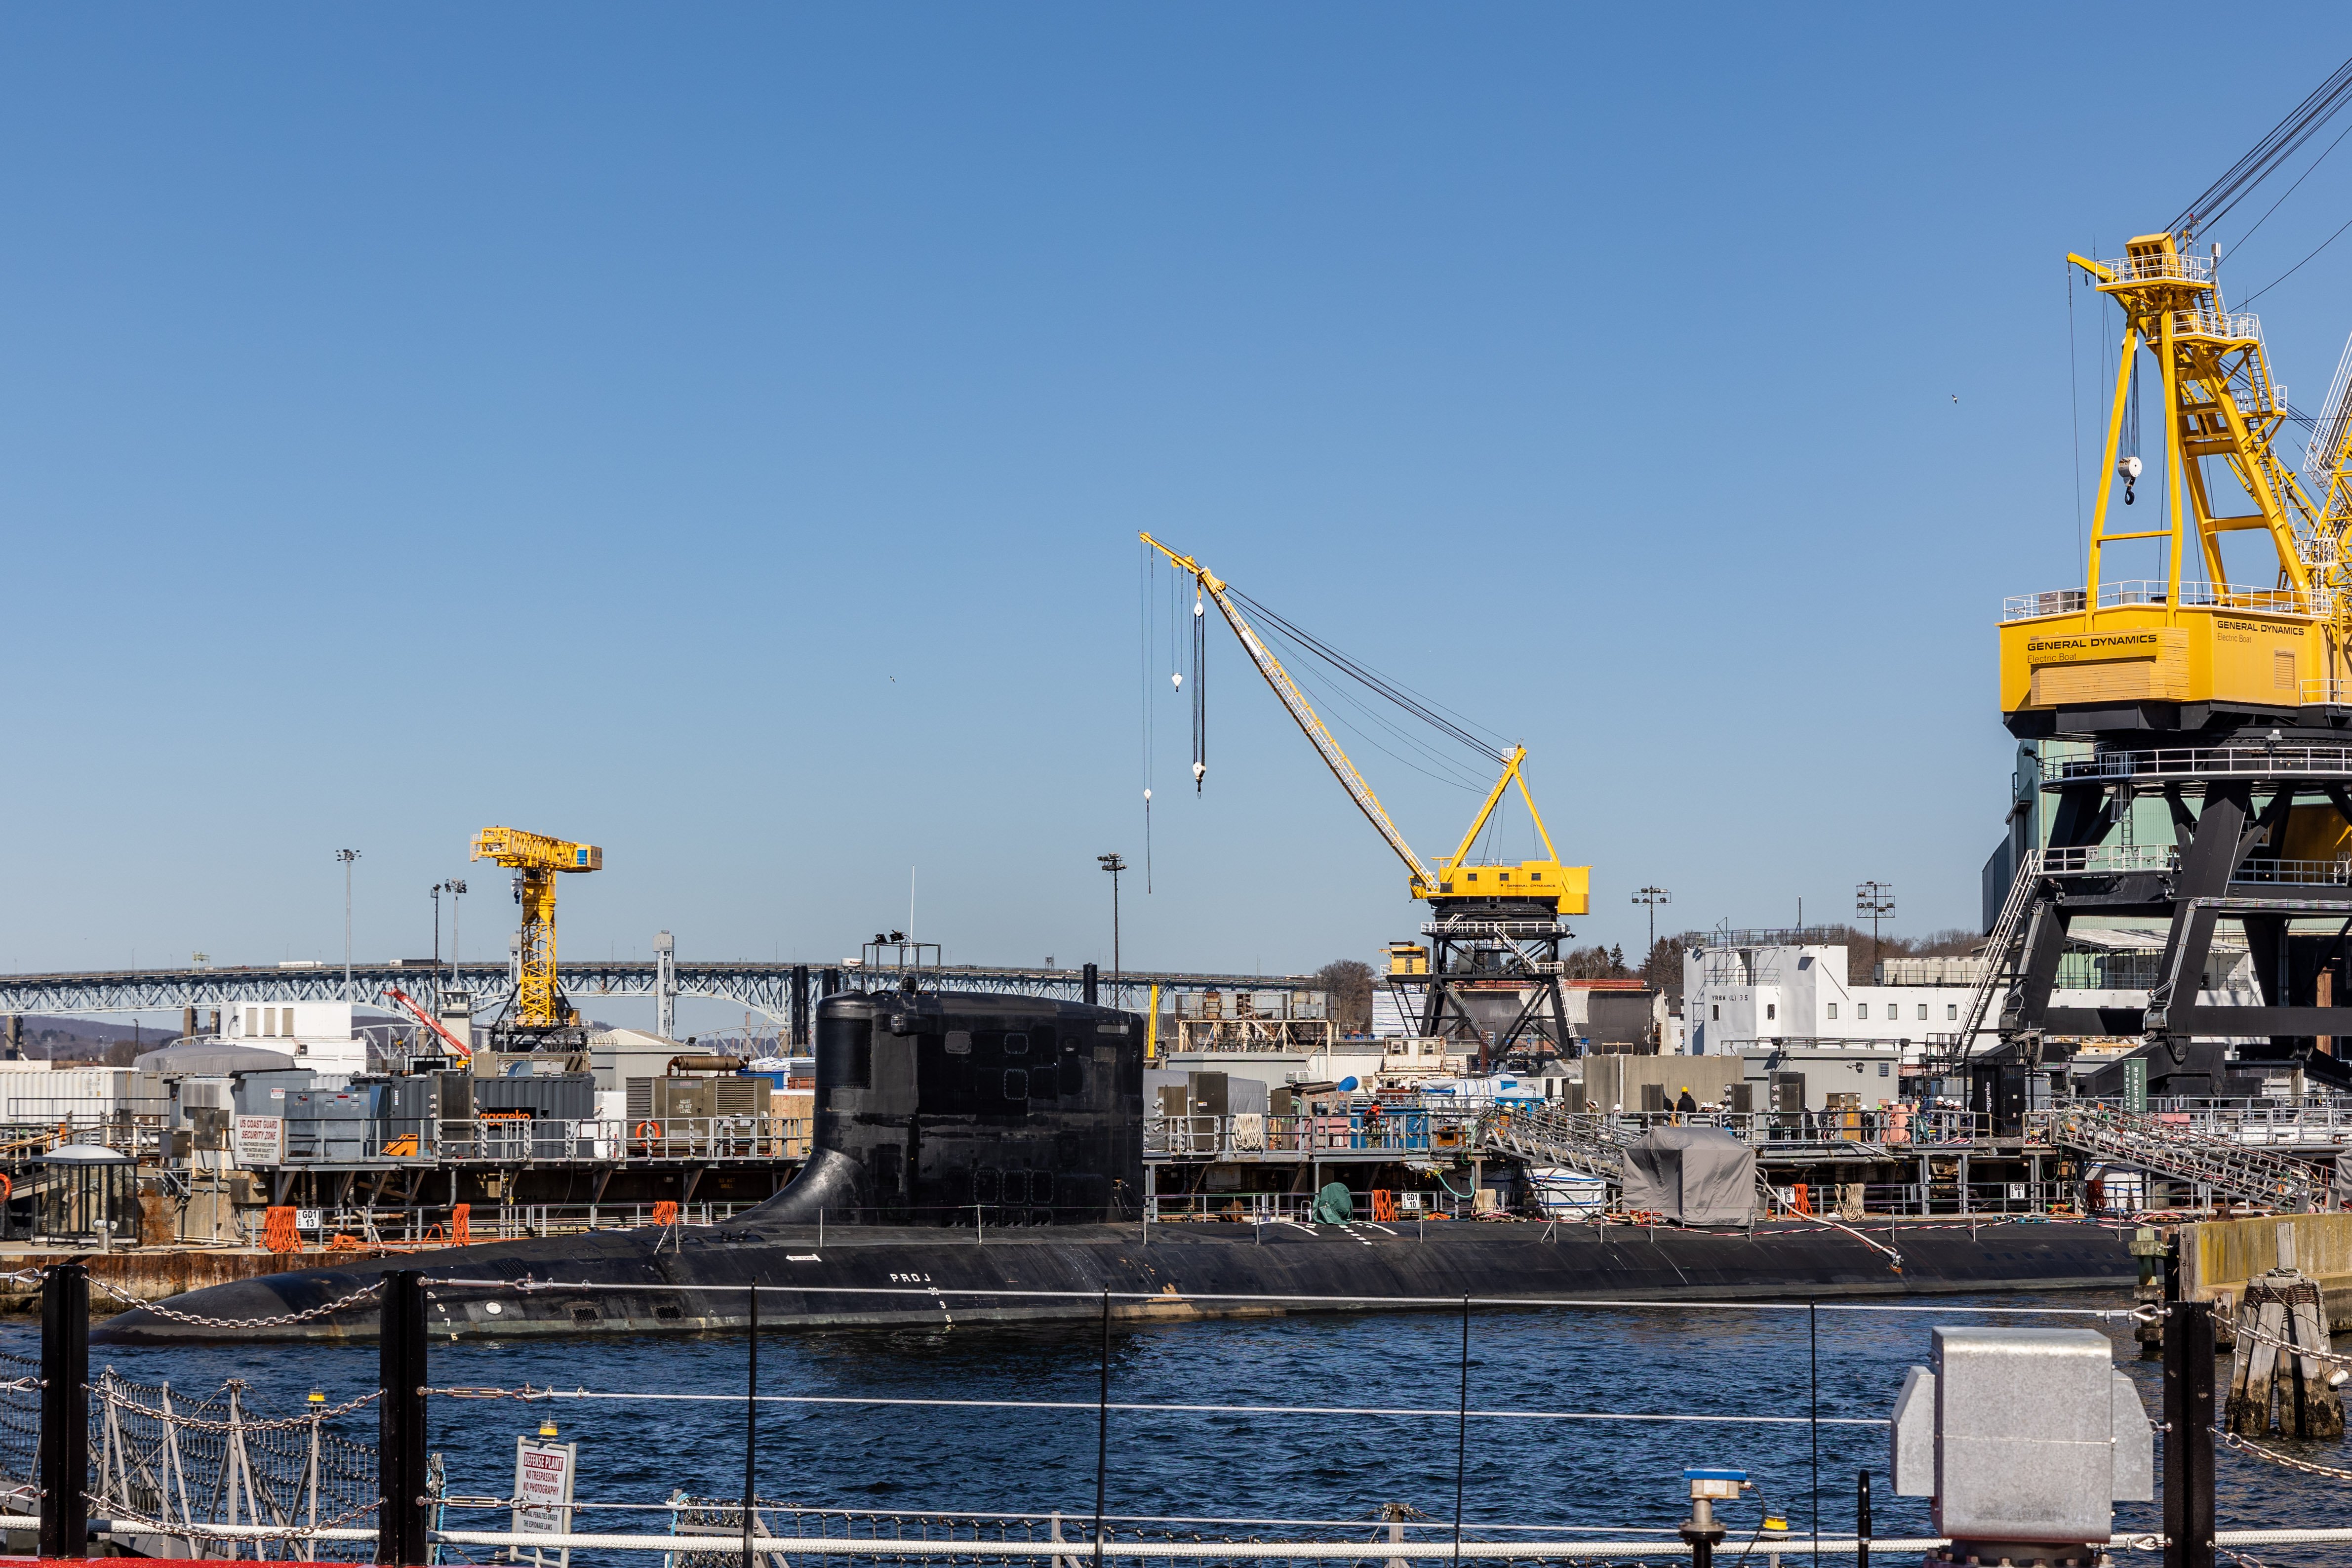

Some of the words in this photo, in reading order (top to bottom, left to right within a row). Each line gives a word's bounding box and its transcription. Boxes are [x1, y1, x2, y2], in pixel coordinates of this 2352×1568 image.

[2218, 621, 2258, 631] GENERAL
[2261, 624, 2304, 636] DYNAMICS
[2028, 640, 2087, 651] GENERAL
[2091, 635, 2157, 647] DYNAMICS
[2217, 633, 2237, 642] Electric
[2239, 635, 2251, 643] Boat
[2028, 654, 2056, 663] Electric
[403, 999, 419, 1011] SANY
[480, 1109, 530, 1126] aggreko
[239, 1119, 246, 1128] US
[247, 1120, 262, 1128] COAST
[263, 1120, 278, 1129] GUARD
[241, 1130, 264, 1139] SECURITY
[265, 1131, 277, 1140] ZONE
[437, 1304, 445, 1312] 8
[939, 1301, 946, 1309] 9
[444, 1318, 450, 1327] 7
[450, 1332, 458, 1341] 6
[524, 1453, 545, 1468] DEFENSE
[545, 1457, 563, 1470] PLANT
[525, 1470, 530, 1479] NO
[532, 1471, 558, 1484] TRESPASSING
[523, 1482, 528, 1491] NO
[529, 1483, 559, 1496] PHOTOGRAPHY
[533, 1511, 547, 1520] PENALTIES
